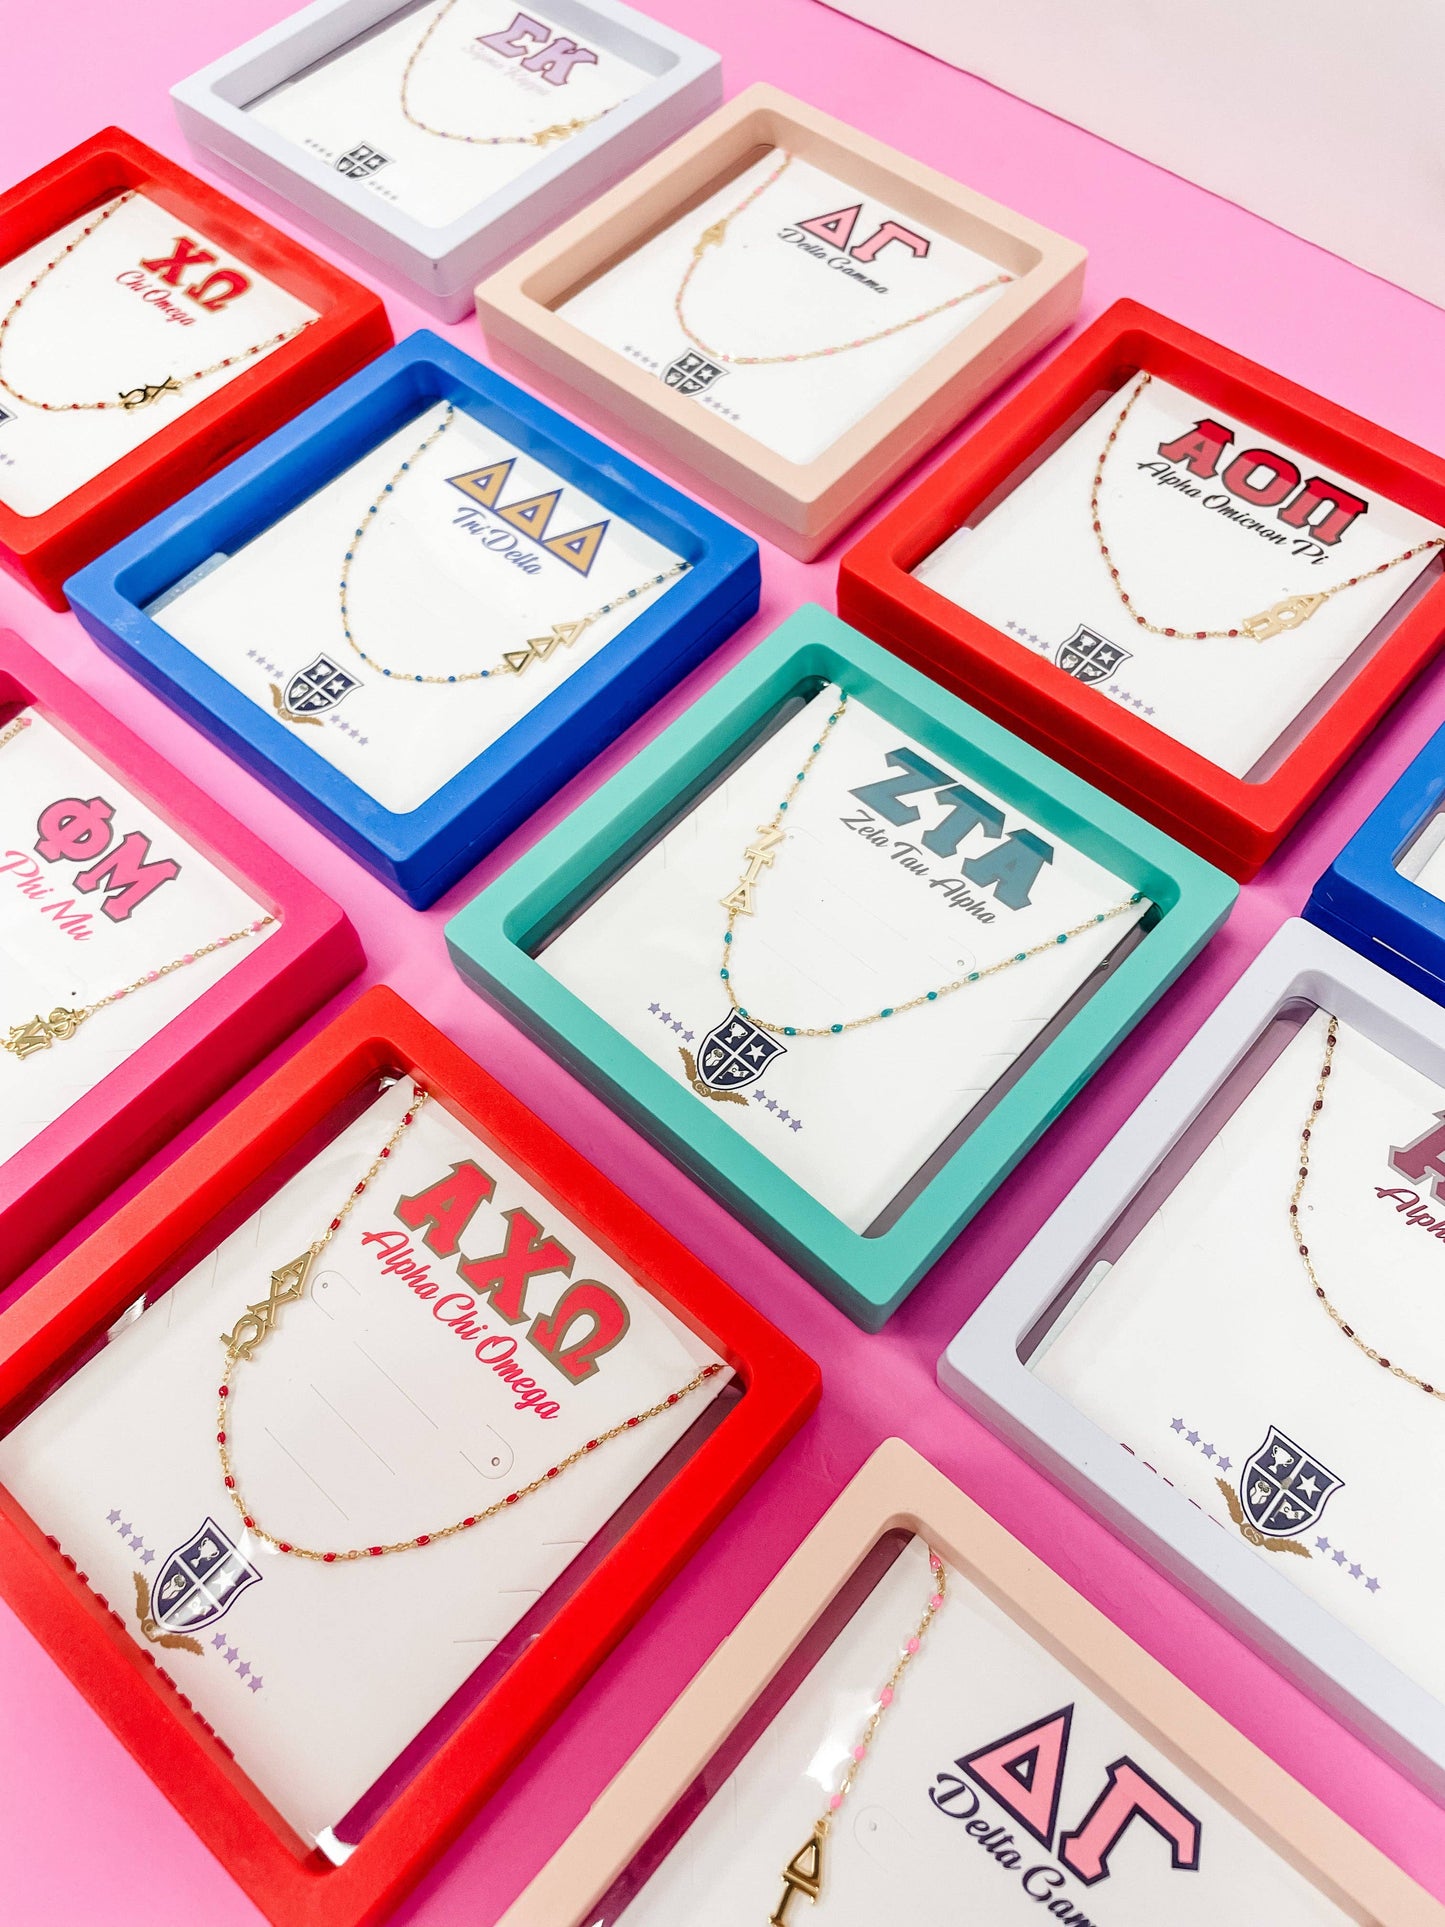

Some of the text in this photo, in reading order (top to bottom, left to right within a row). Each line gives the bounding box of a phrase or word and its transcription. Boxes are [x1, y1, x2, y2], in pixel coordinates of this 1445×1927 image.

[777, 227, 889, 295] Delta Gamma
[794, 203, 931, 264] ΔΓ
[116, 270, 197, 327] Chi Omega
[444, 457, 612, 579] ΔΔΔ
[451, 506, 544, 576] Tri Delta
[1137, 461, 1329, 566] Alpha Omicron Pi
[0, 850, 94, 942] Phi Mu
[839, 808, 997, 925] Zeta Tau Alpha
[361, 1231, 561, 1420] Alpha Chi Omega
[928, 1773, 1021, 1870] Delta
[954, 1702, 1202, 1887] ΔΓ
